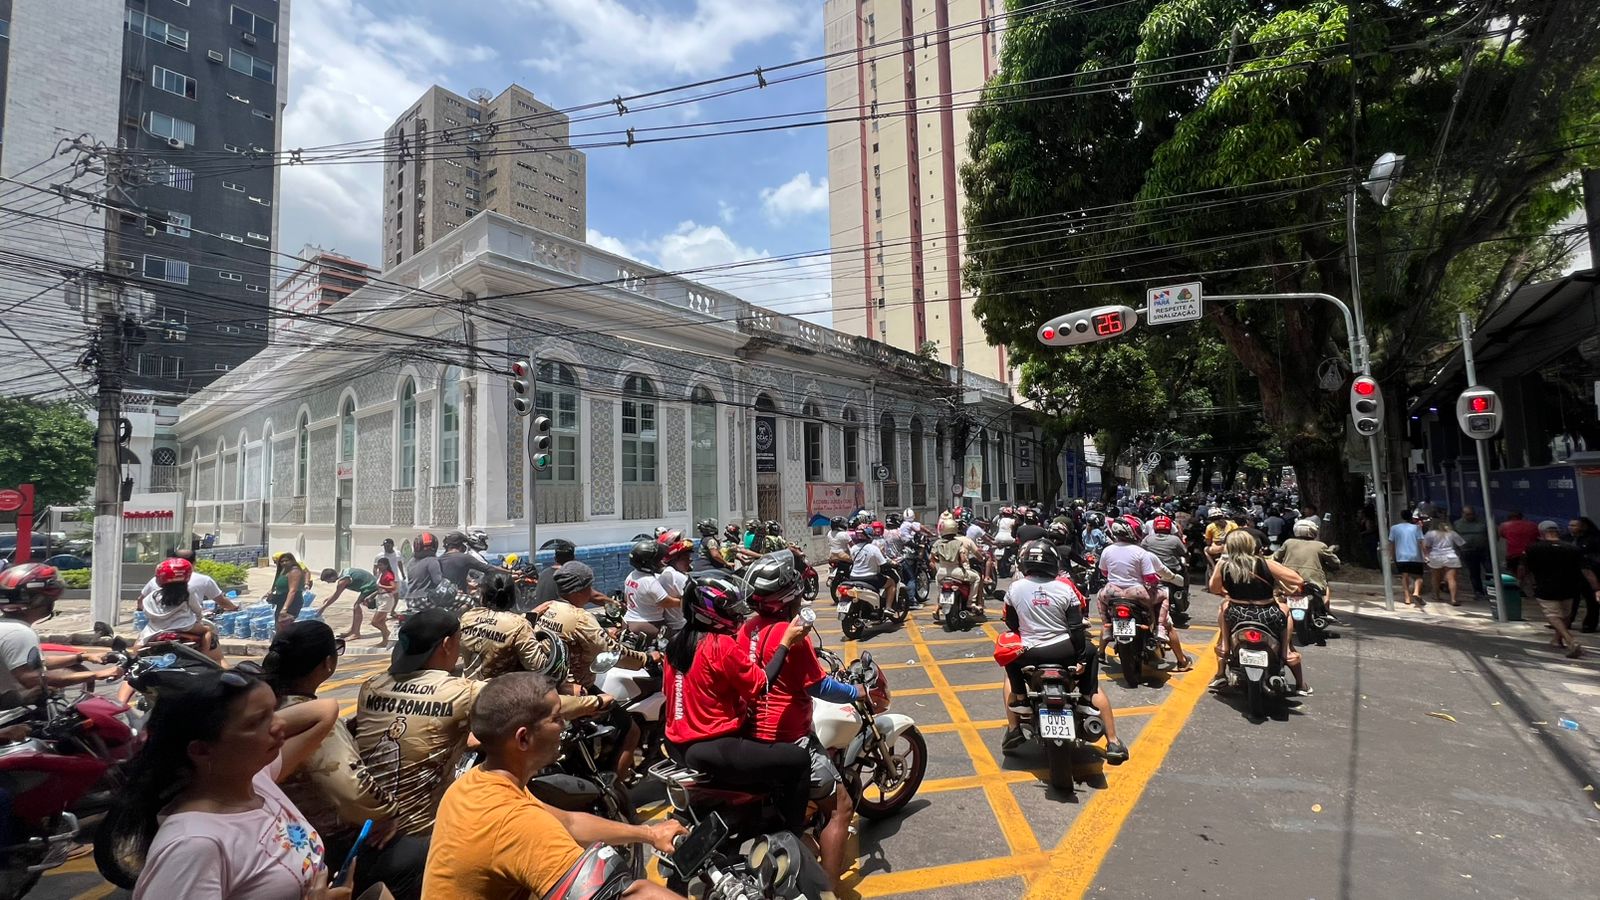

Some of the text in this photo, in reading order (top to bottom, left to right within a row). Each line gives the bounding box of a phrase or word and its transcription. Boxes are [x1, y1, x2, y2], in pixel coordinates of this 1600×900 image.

[1154, 310, 1197, 320] SINALIZAÇÃO
[1156, 305, 1186, 314] RESPEITE
[1097, 312, 1123, 335] 26
[478, 627, 507, 643] ROMARIA
[391, 682, 437, 695] MARLON
[366, 695, 453, 717] MOTO ROMARIA
[1045, 725, 1071, 736] 9B21
